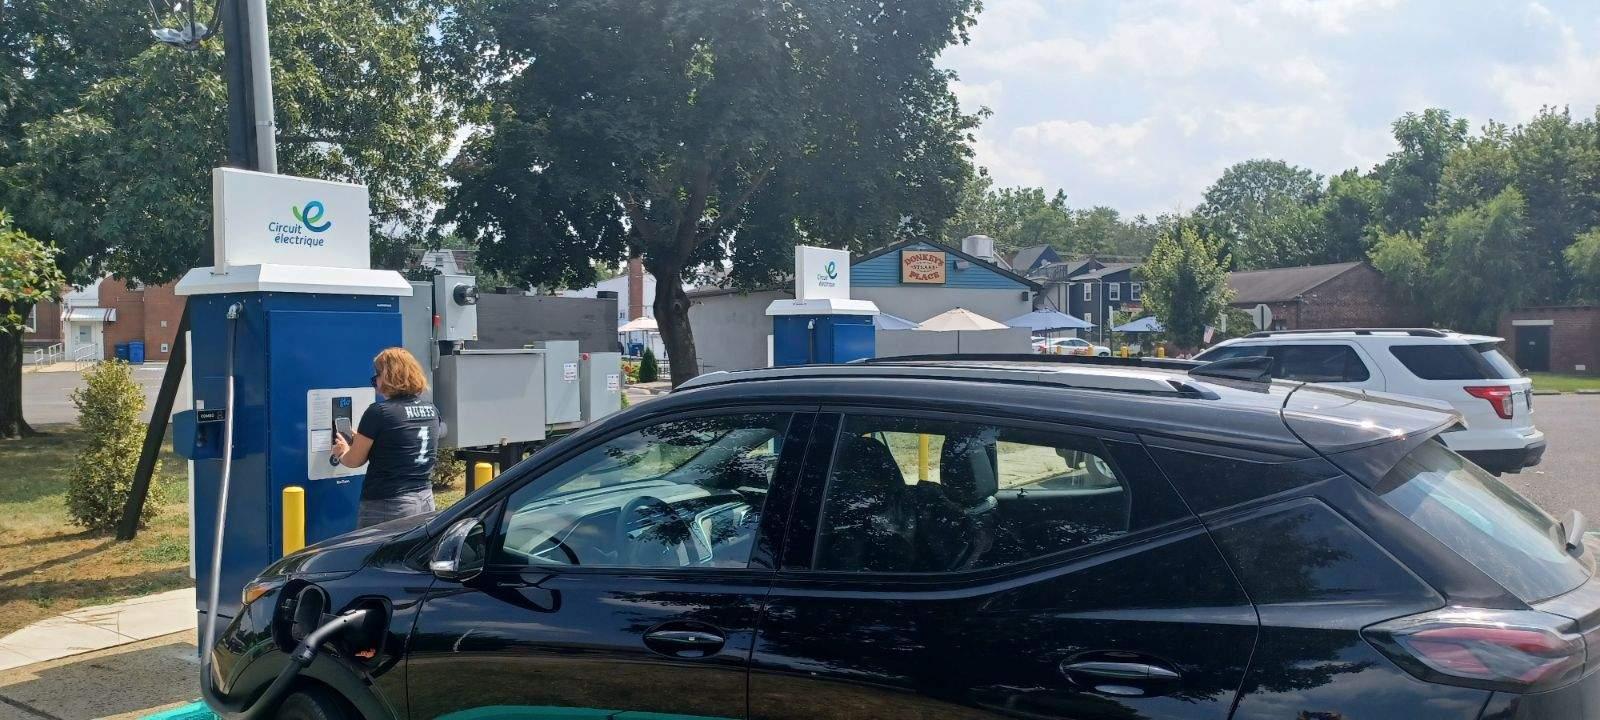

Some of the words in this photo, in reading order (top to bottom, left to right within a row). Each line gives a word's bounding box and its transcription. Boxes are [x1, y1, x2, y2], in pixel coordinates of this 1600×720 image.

[268, 221, 303, 235] Circuit
[274, 233, 325, 248] électrique
[908, 271, 941, 281] PLACE
[404, 405, 435, 419] HURTS
[414, 426, 430, 465] 1
